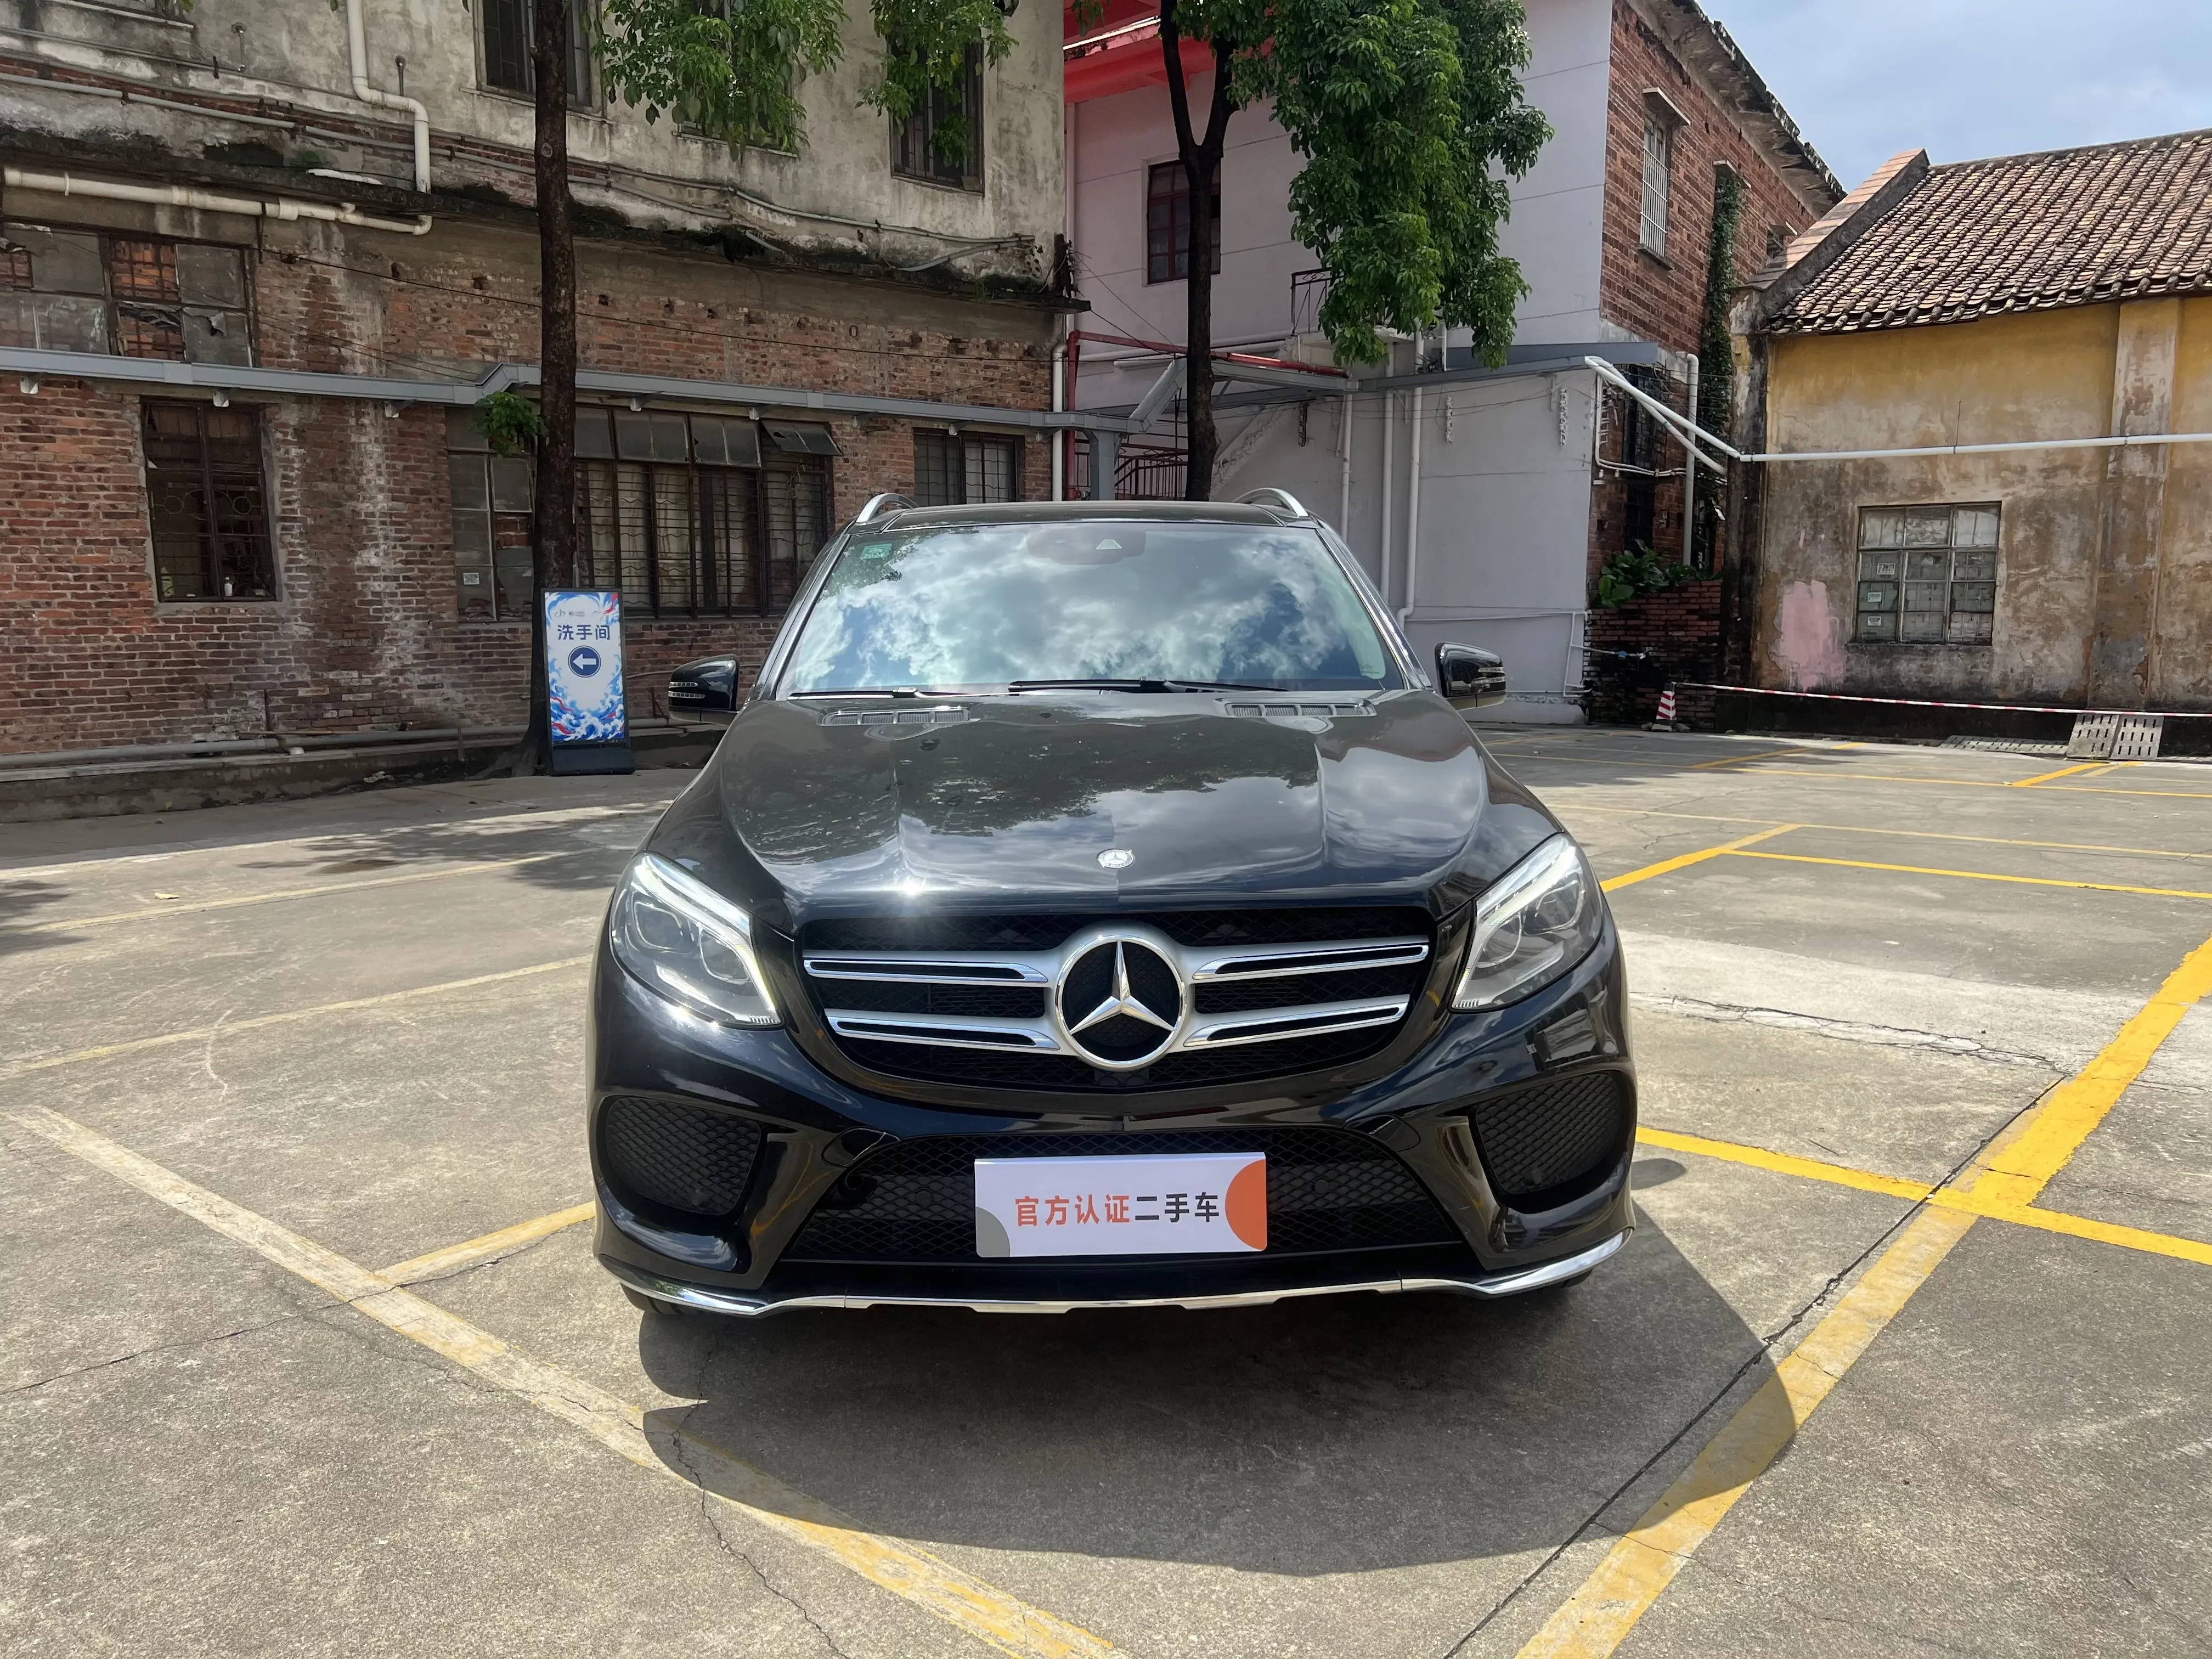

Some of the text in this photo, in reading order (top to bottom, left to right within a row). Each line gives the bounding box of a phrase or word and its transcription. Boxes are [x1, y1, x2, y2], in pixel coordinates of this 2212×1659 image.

[557, 624, 610, 640] 洗手间
[1015, 1192, 1219, 1227] 官方认证二手车
